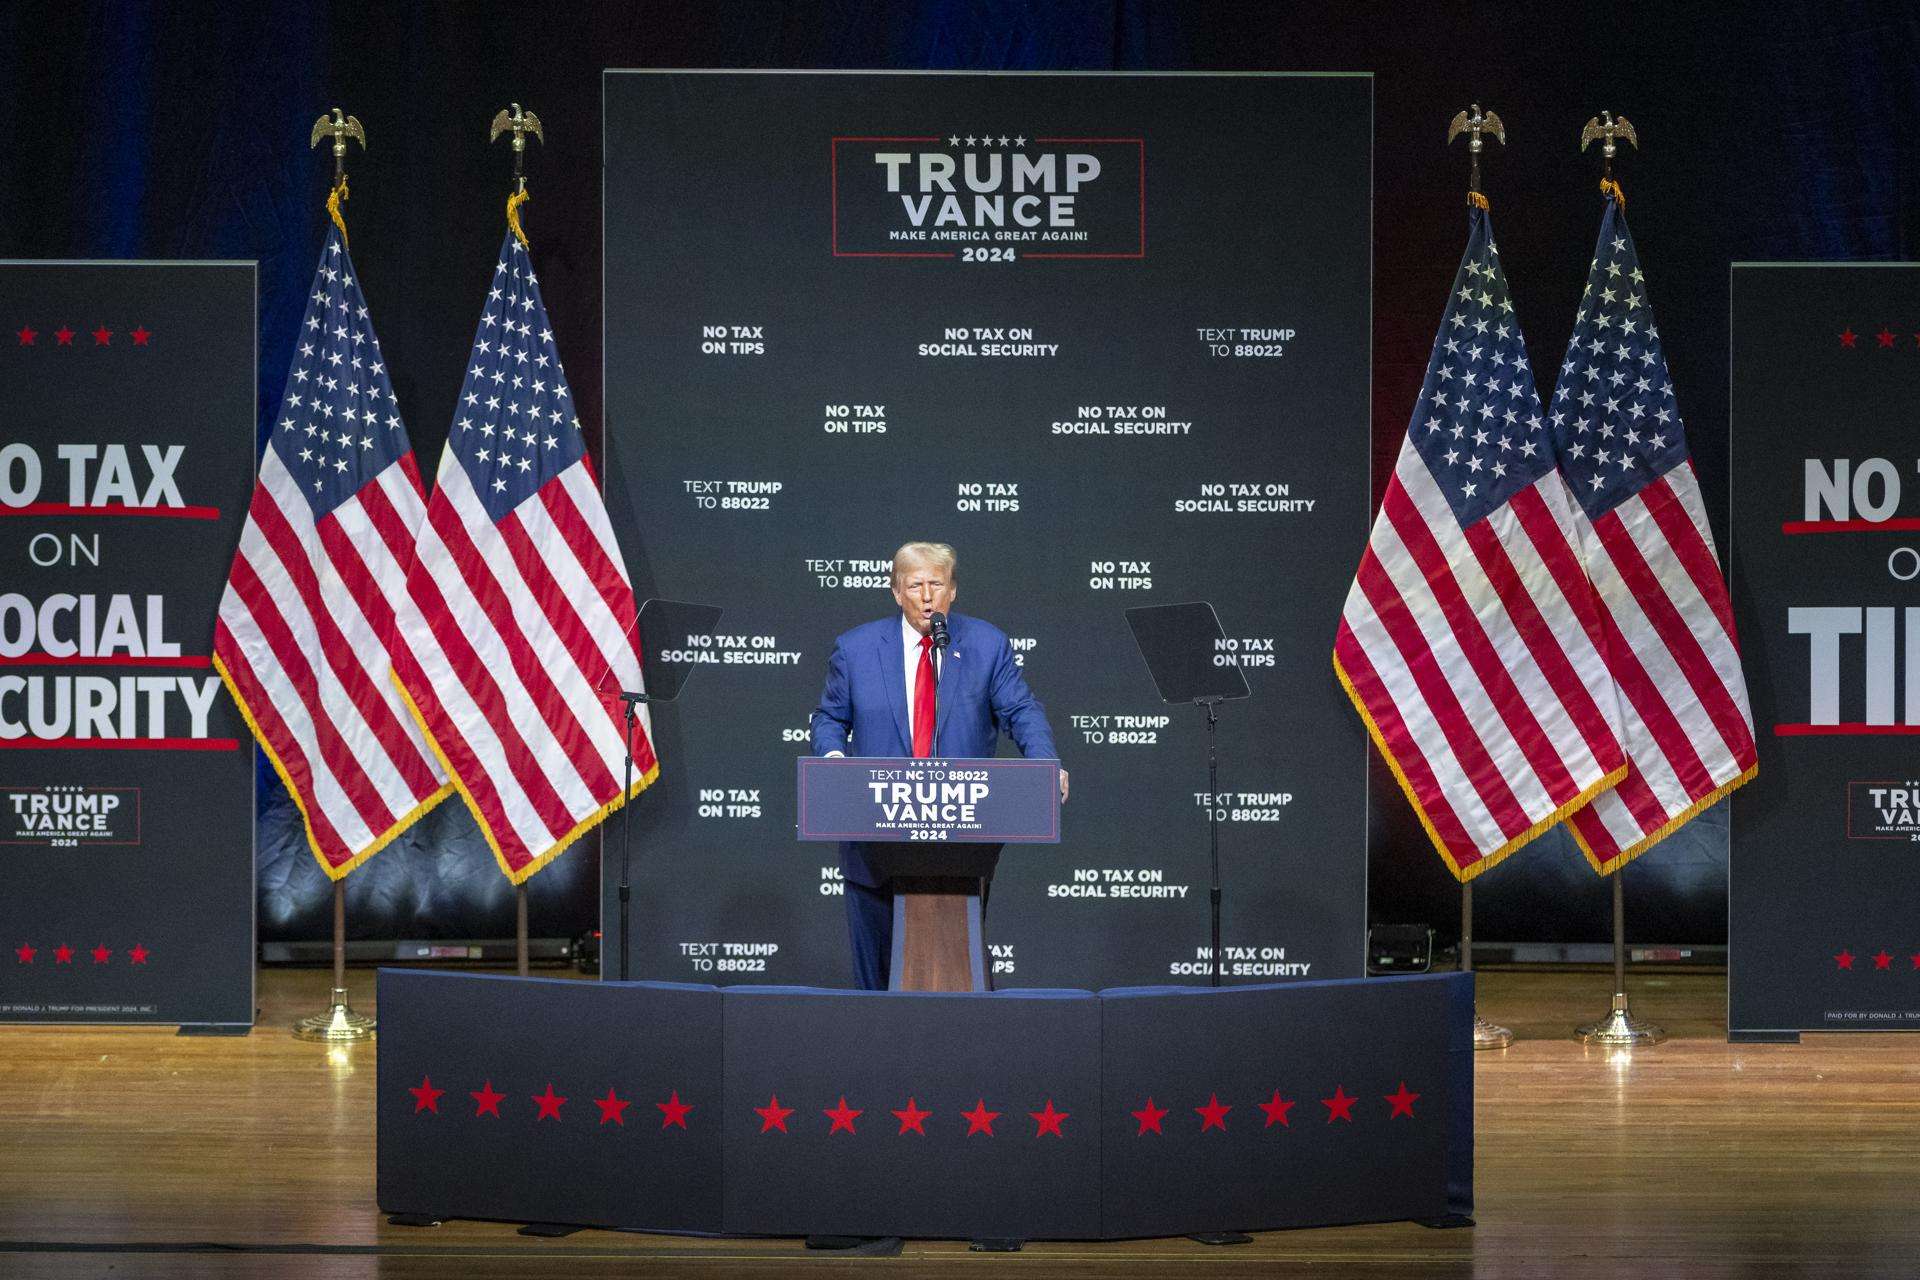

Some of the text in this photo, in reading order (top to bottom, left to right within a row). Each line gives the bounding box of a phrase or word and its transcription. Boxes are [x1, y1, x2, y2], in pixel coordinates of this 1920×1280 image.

[875, 153, 1101, 193] TRUMP
[901, 195, 1075, 227] VANCE
[890, 231, 1087, 240] MAKE AMERICA GREAT AGAIN!
[963, 248, 1015, 262] 2024
[704, 326, 763, 338] NO TAX
[945, 328, 1032, 340] NO TAX ON
[1197, 329, 1295, 341] TEXT TRUMP
[702, 342, 764, 354] ON TIPS
[919, 344, 1058, 356] SOCIAL SECURITY
[1209, 345, 1282, 356] TO 88022
[826, 405, 885, 417] NO TAX
[1078, 407, 1165, 418] NO TAX ON
[824, 421, 886, 433] ON TIPS
[1052, 422, 1191, 434] SOCIAL SECURITY
[0, 443, 186, 508] O TAX
[683, 481, 782, 493] TEXT TRUMP
[959, 483, 1018, 495] NO TAX
[1202, 484, 1288, 496] NO TAX ON
[1805, 458, 1900, 522] NO
[696, 497, 769, 509] TO 88022
[957, 499, 1019, 511] ON TIPS
[1175, 500, 1315, 512] SOCIAL SECURITY
[29, 533, 99, 566] ON
[805, 560, 894, 572] TEXT TRUM
[1092, 562, 1150, 573] NO TAX
[1888, 547, 1920, 580] O
[818, 576, 891, 588] TO 88022
[1090, 577, 1152, 589] ON TIPS
[0, 593, 181, 658] OCIAL
[687, 634, 775, 648] NO TAX ON
[1215, 638, 1273, 651] NO TAX
[660, 650, 801, 664] SOCIAL SECURITY
[1213, 654, 1275, 667] ON TIPS
[0, 675, 223, 740] CURITY
[1071, 716, 1169, 728] TEXT TRUMP
[1083, 731, 1156, 744] TO 88022
[870, 770, 988, 781] TEXT NC TO 88022
[700, 789, 759, 802] NO TAX
[869, 782, 989, 804] TRUMP
[1237, 793, 1292, 805] TRUMP
[10, 794, 119, 814] TRUMP
[698, 805, 761, 817] ON TIPS
[882, 804, 975, 821] VANCE
[1232, 809, 1279, 821] 88022
[22, 814, 106, 830] VANCE
[911, 830, 947, 840] 2024
[51, 839, 77, 847] 2024
[1075, 870, 1162, 882] NO TAX ON
[820, 883, 844, 895] ON
[1048, 885, 1188, 897] SOCIAL SECURITY
[679, 943, 778, 955] TEXT TRUMP
[987, 945, 1014, 957] AX
[1225, 947, 1257, 960] TAX
[1261, 948, 1284, 960] ON
[692, 959, 765, 971] TO 88022
[992, 961, 1015, 973] PS
[1232, 963, 1311, 976] SECURITY
